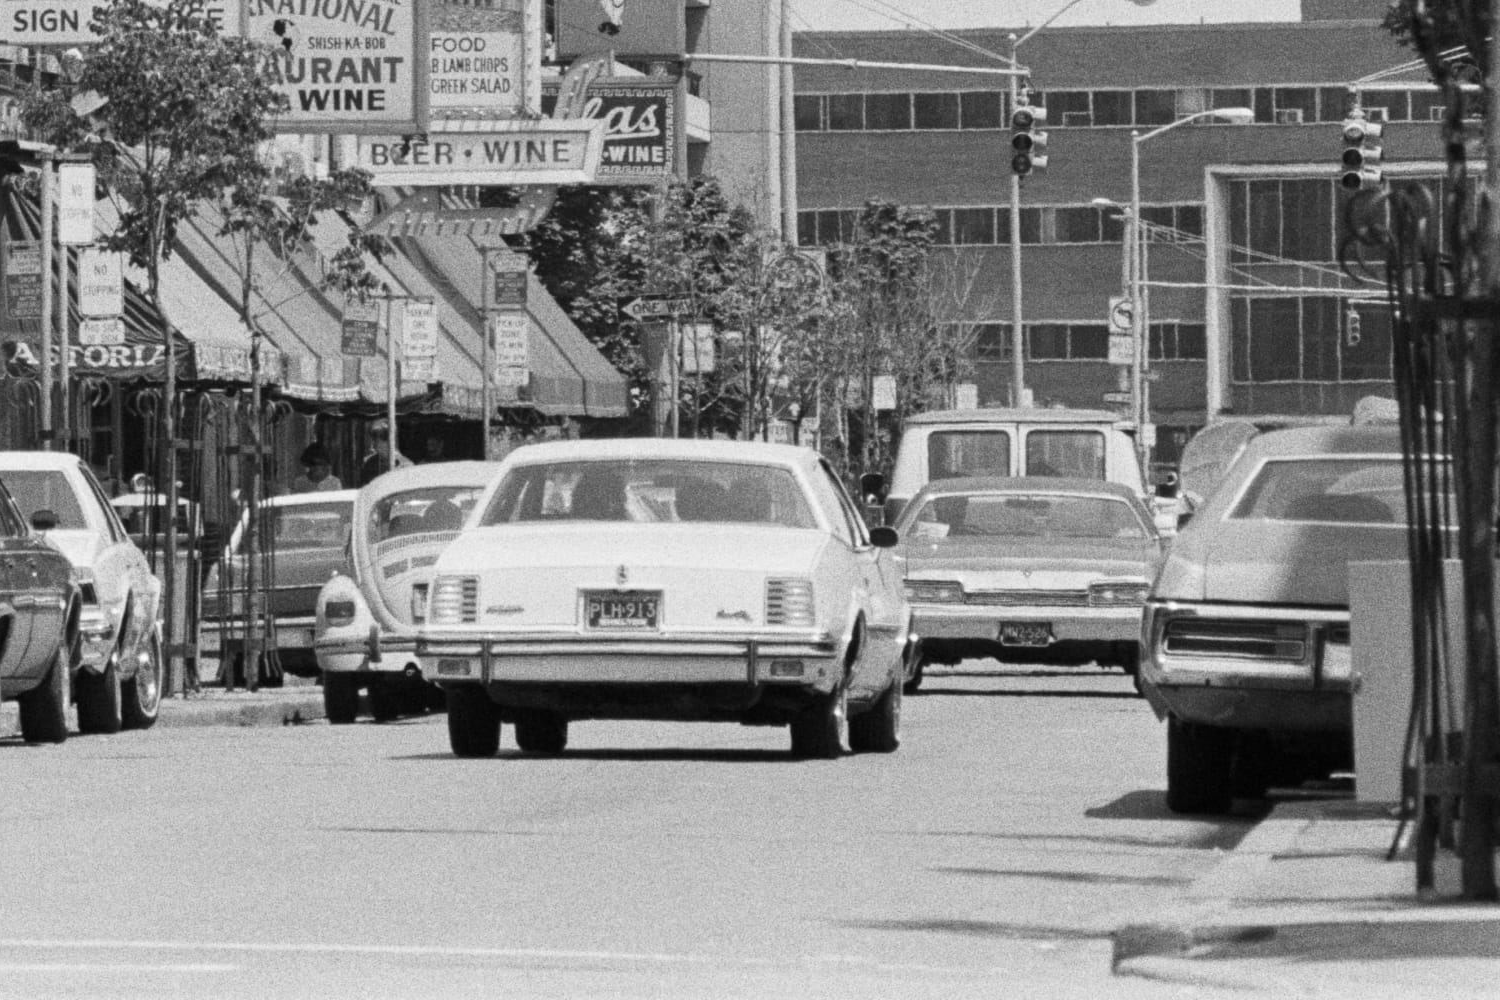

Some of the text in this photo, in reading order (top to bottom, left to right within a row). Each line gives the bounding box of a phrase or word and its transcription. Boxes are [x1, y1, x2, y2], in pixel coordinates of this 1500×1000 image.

[13, 8, 79, 33] SIGN
[431, 36, 486, 53] FOOD
[443, 57, 472, 74] LAMB
[471, 77, 511, 94] SALAD
[298, 89, 386, 112] WINE
[483, 139, 571, 165] WINE
[608, 145, 664, 163] WINE
